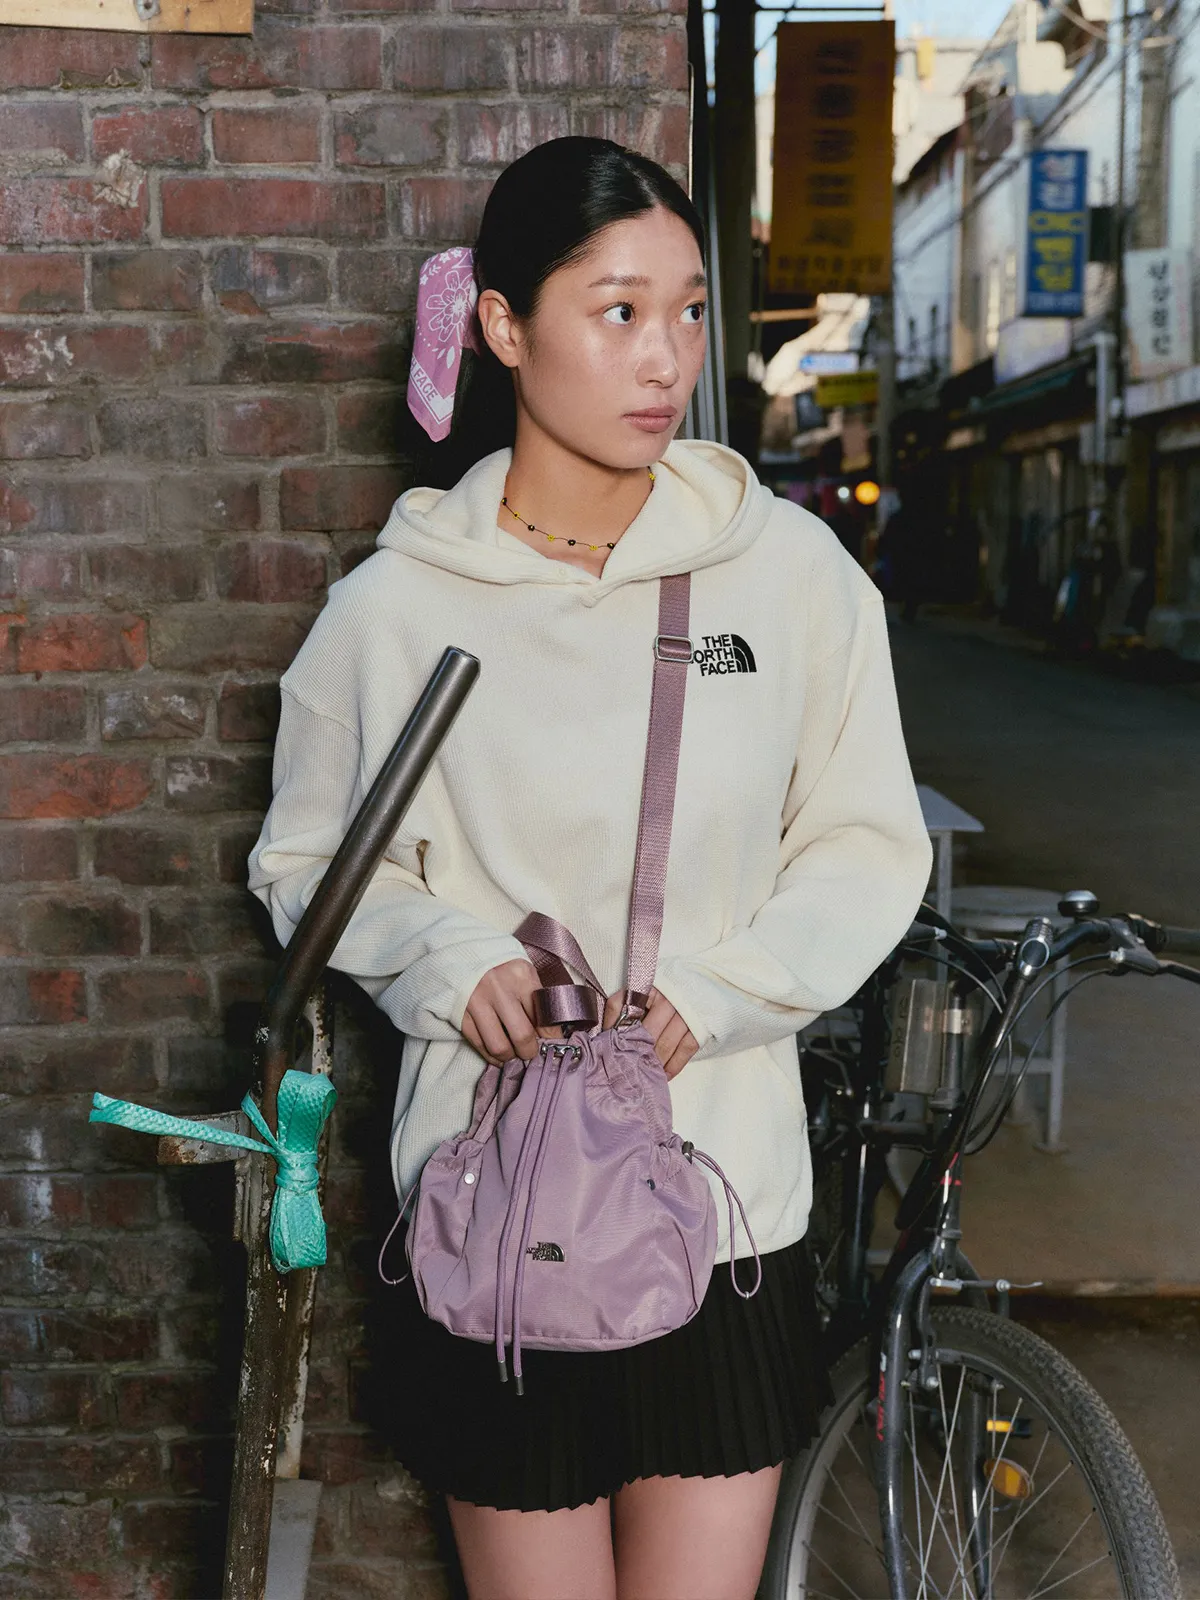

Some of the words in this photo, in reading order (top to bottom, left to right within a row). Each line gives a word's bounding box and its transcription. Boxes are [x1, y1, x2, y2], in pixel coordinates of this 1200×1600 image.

[413, 368, 438, 401] FACE
[702, 634, 732, 649] THE
[691, 647, 734, 664] ORTH
[700, 660, 736, 677] FACE
